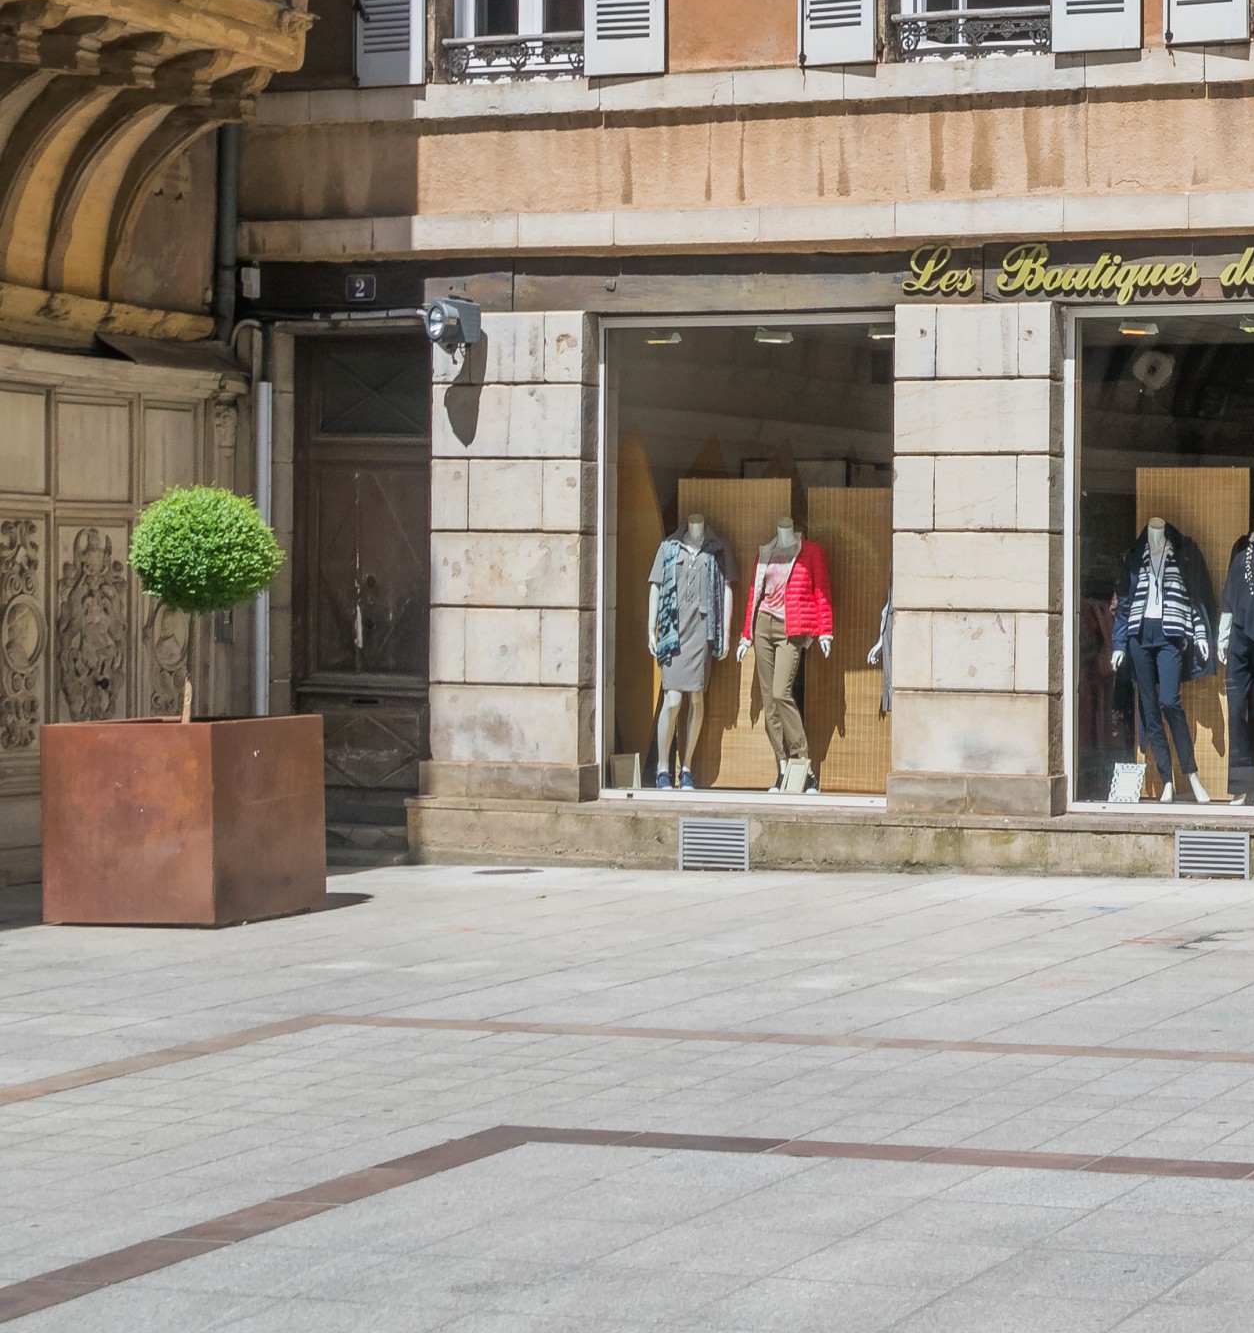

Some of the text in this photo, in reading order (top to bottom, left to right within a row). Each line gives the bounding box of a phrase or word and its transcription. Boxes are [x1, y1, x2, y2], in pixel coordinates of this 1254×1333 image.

[356, 278, 365, 297] 2
[902, 243, 975, 293] Les
[996, 243, 1201, 306] Boutiques
